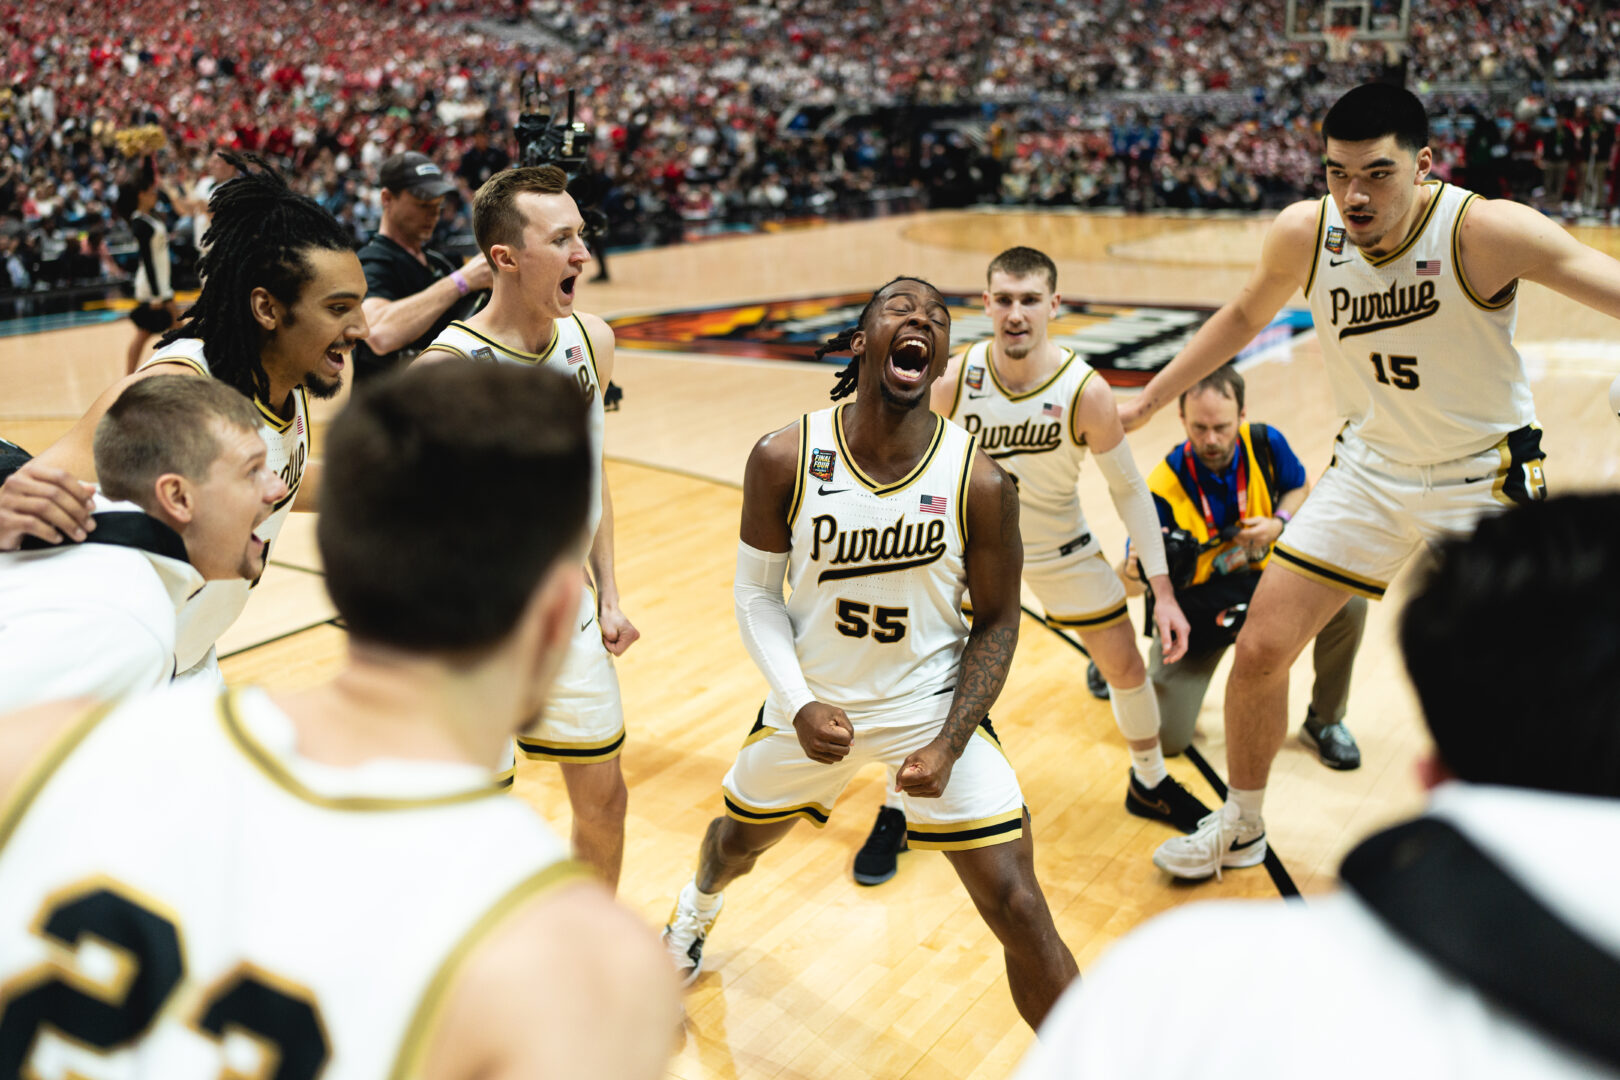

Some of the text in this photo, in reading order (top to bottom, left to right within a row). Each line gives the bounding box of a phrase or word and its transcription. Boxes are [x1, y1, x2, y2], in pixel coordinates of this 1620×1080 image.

[1329, 279, 1440, 328] Purdue
[1369, 352, 1420, 391] 15
[964, 415, 1062, 452] Purdue
[813, 461, 830, 469] FOUR
[814, 454, 832, 462] FINAL
[810, 513, 947, 570] Purdue
[835, 597, 909, 644] 55
